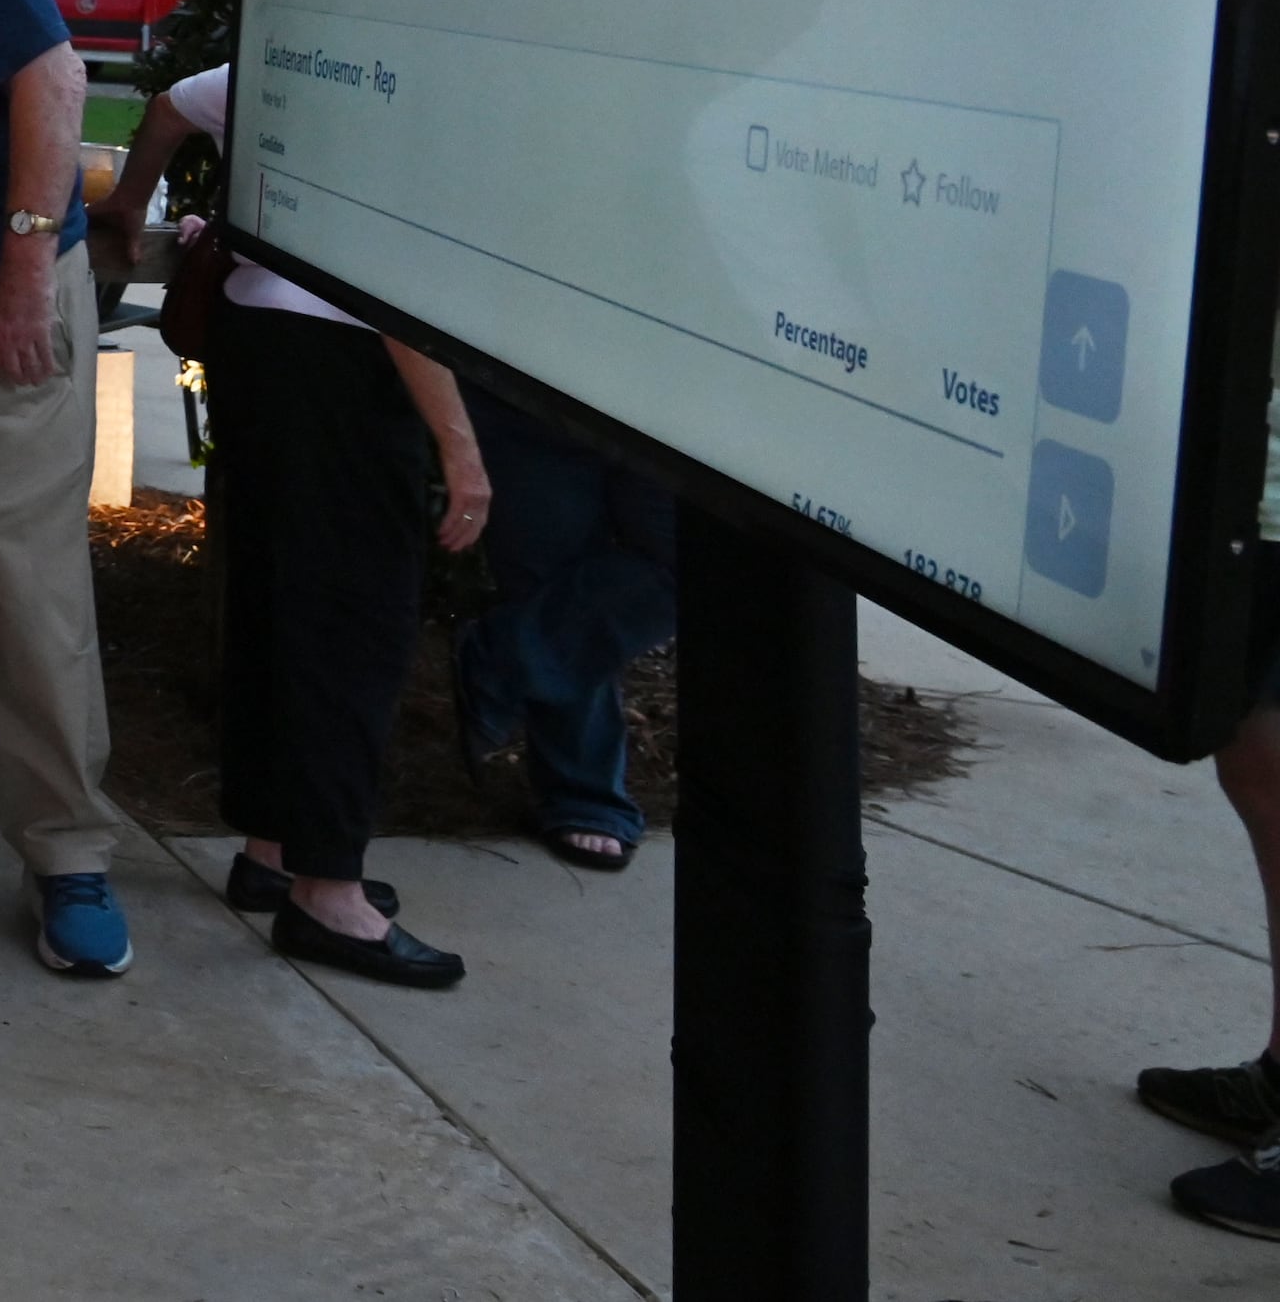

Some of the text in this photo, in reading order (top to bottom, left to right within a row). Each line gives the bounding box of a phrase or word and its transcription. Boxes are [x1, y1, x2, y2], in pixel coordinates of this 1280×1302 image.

[264, 38, 312, 76] Lieutenant
[313, 50, 363, 88] Governor
[373, 61, 397, 104] Rep
[774, 139, 1001, 216] Vote Method Follow
[774, 310, 1001, 417] Percentage Votes
[791, 493, 982, 602] 5467% 182878
